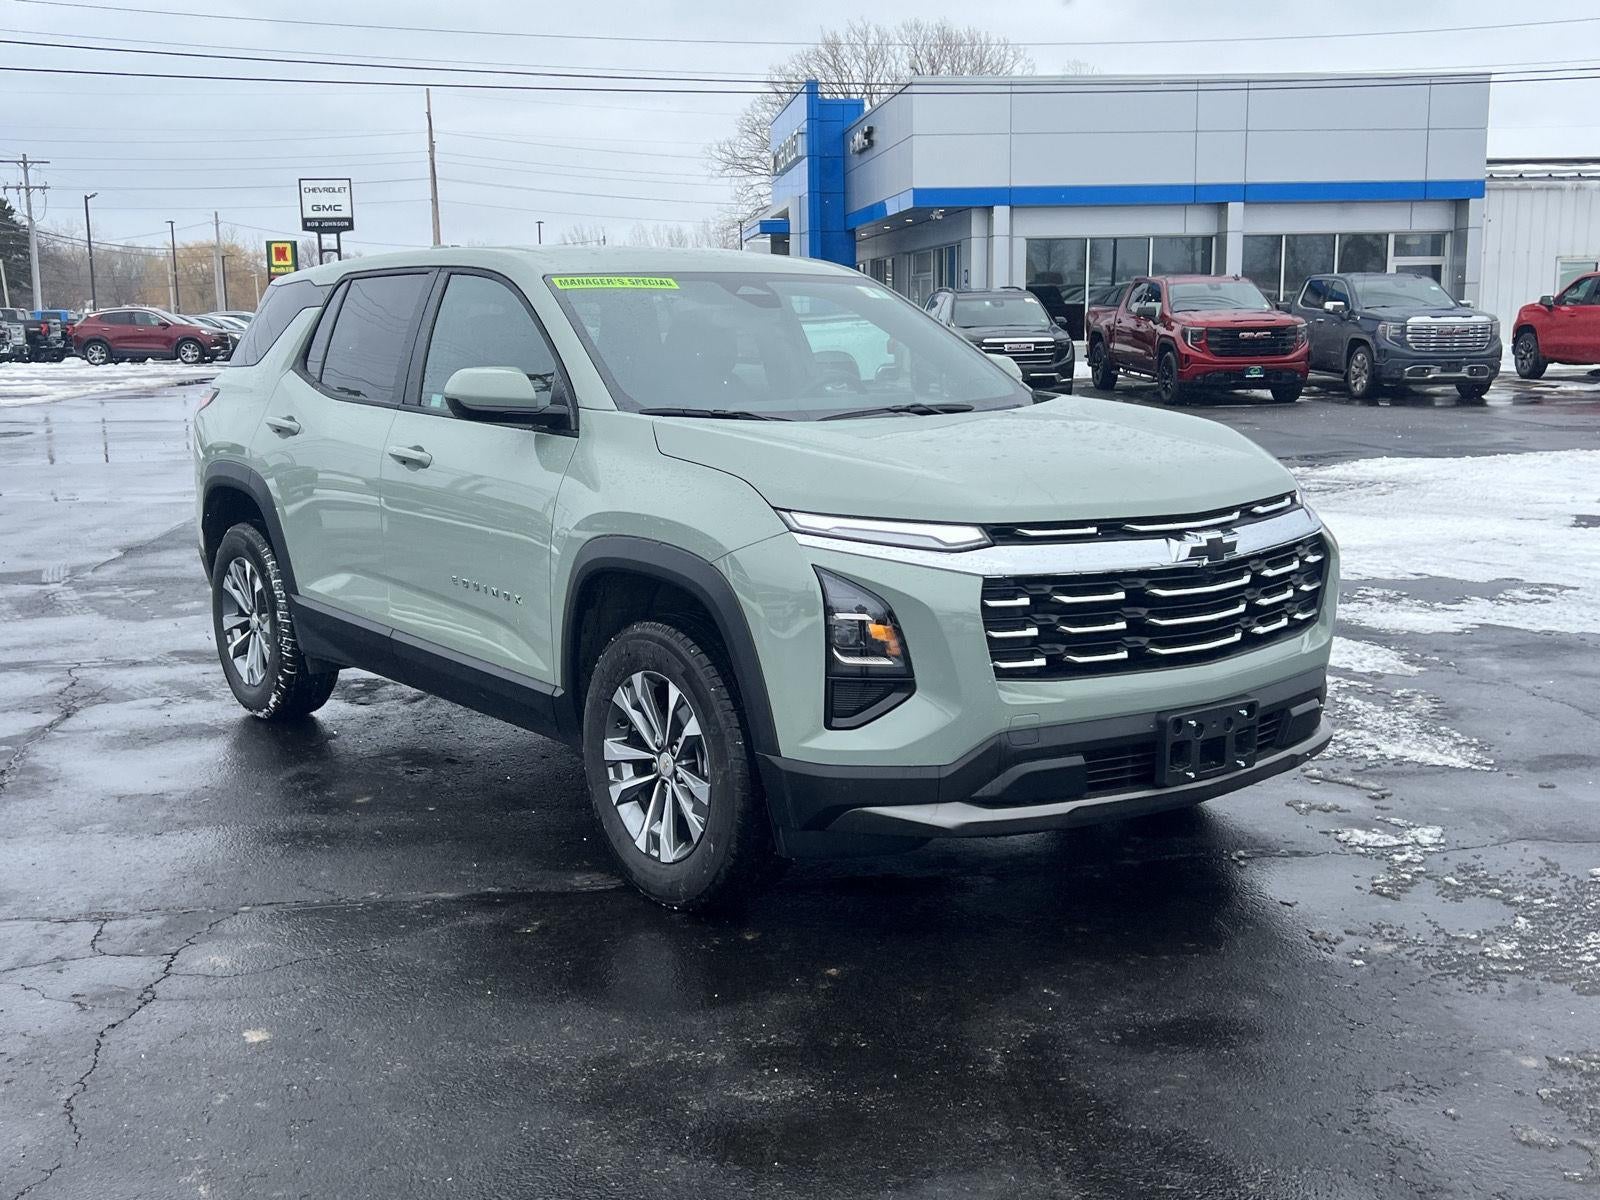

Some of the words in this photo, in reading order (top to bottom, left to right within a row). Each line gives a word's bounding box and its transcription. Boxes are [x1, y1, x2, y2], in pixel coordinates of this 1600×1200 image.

[311, 204, 342, 212] GMC
[274, 246, 289, 261] K
[559, 279, 625, 287] MANAGER'S
[629, 279, 673, 287] SPECIAL
[1239, 331, 1271, 339] GMC
[451, 575, 523, 606] EQUINOX
